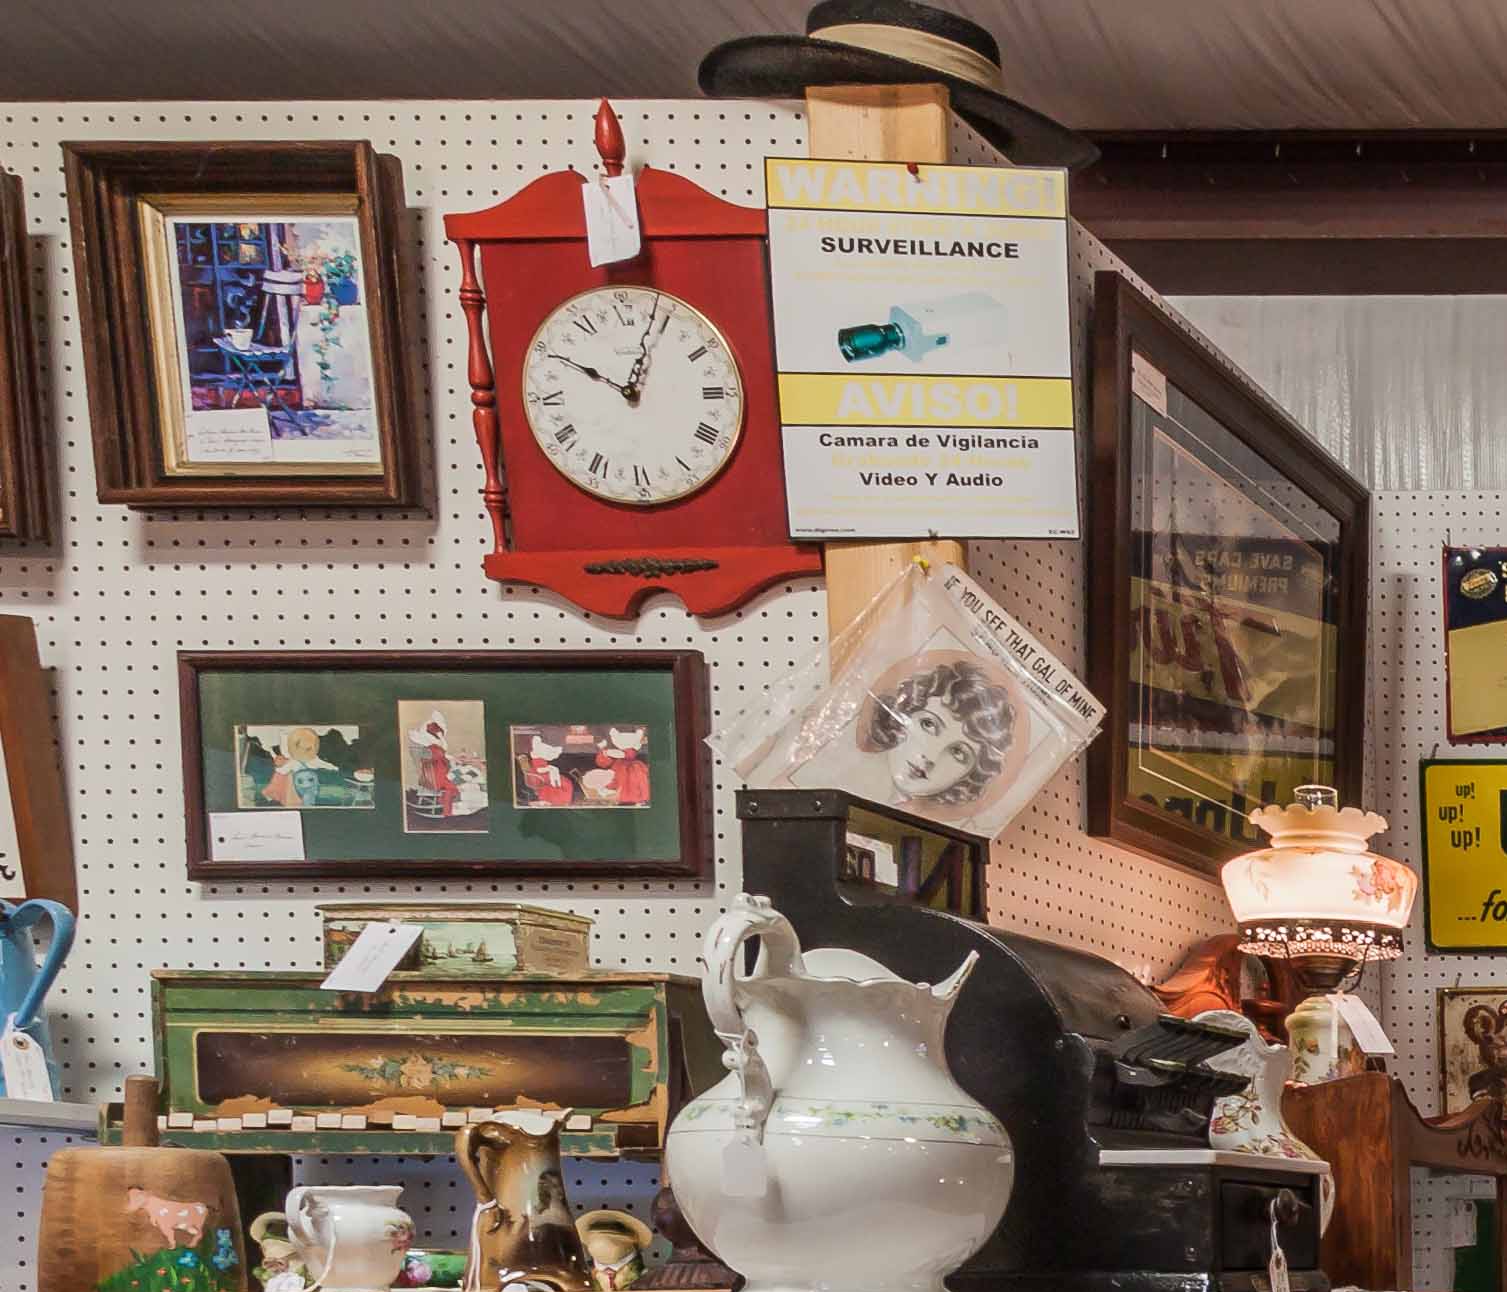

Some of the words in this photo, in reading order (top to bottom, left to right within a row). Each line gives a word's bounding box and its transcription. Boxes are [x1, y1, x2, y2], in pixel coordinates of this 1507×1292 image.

[820, 236, 1019, 259] SURVEILLANCE
[836, 381, 1019, 420] AVISO!
[819, 433, 899, 448] Camara
[905, 434, 930, 448] de
[937, 434, 1040, 451] Vigilancia
[859, 472, 918, 486] Video
[925, 473, 938, 486] Y
[946, 473, 1004, 488] Audio
[960, 586, 985, 615] YOU
[1005, 629, 1037, 663] THAT
[1032, 657, 1057, 684] GAL
[1055, 678, 1074, 697] OF
[1455, 782, 1476, 800] up!
[1438, 802, 1464, 823] up!
[1450, 827, 1482, 850] up!
